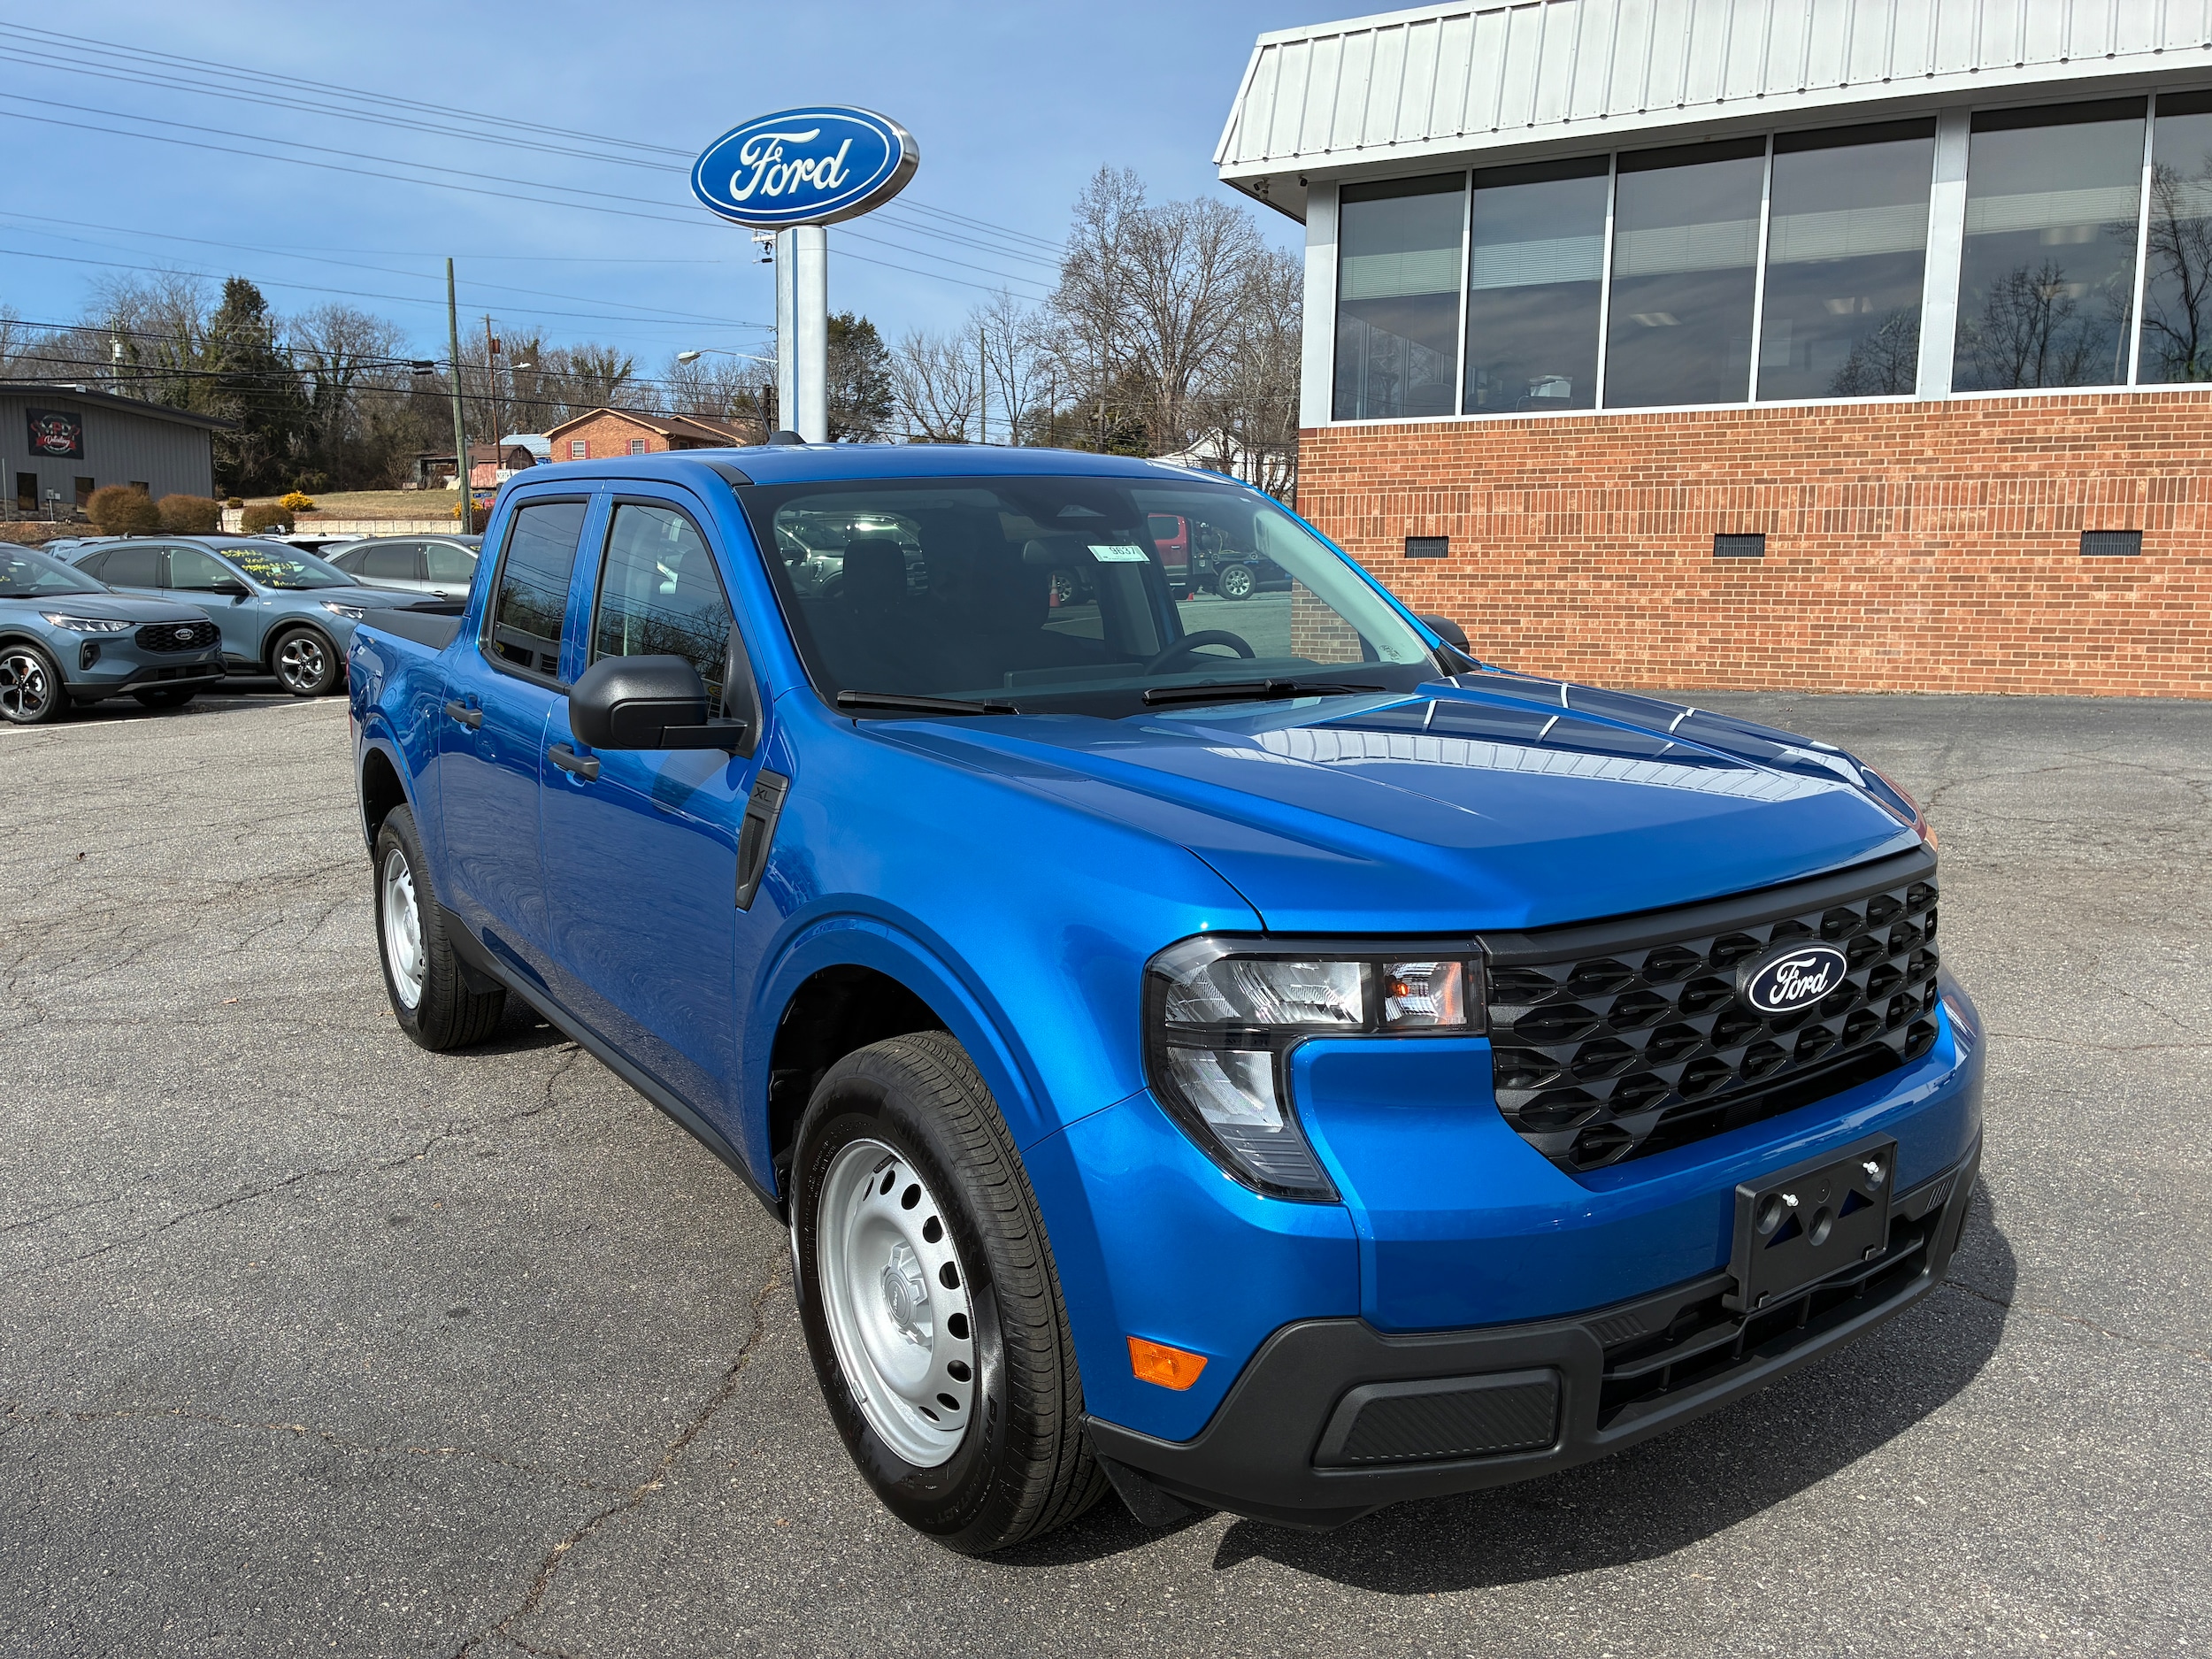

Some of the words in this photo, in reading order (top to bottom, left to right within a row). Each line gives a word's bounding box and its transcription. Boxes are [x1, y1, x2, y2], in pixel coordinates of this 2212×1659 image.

[729, 127, 853, 202] Ford
[43, 434, 71, 448] Detailing
[1109, 546, 1136, 555] 9637
[754, 787, 772, 803] XL
[1769, 956, 1831, 1005] Ford
